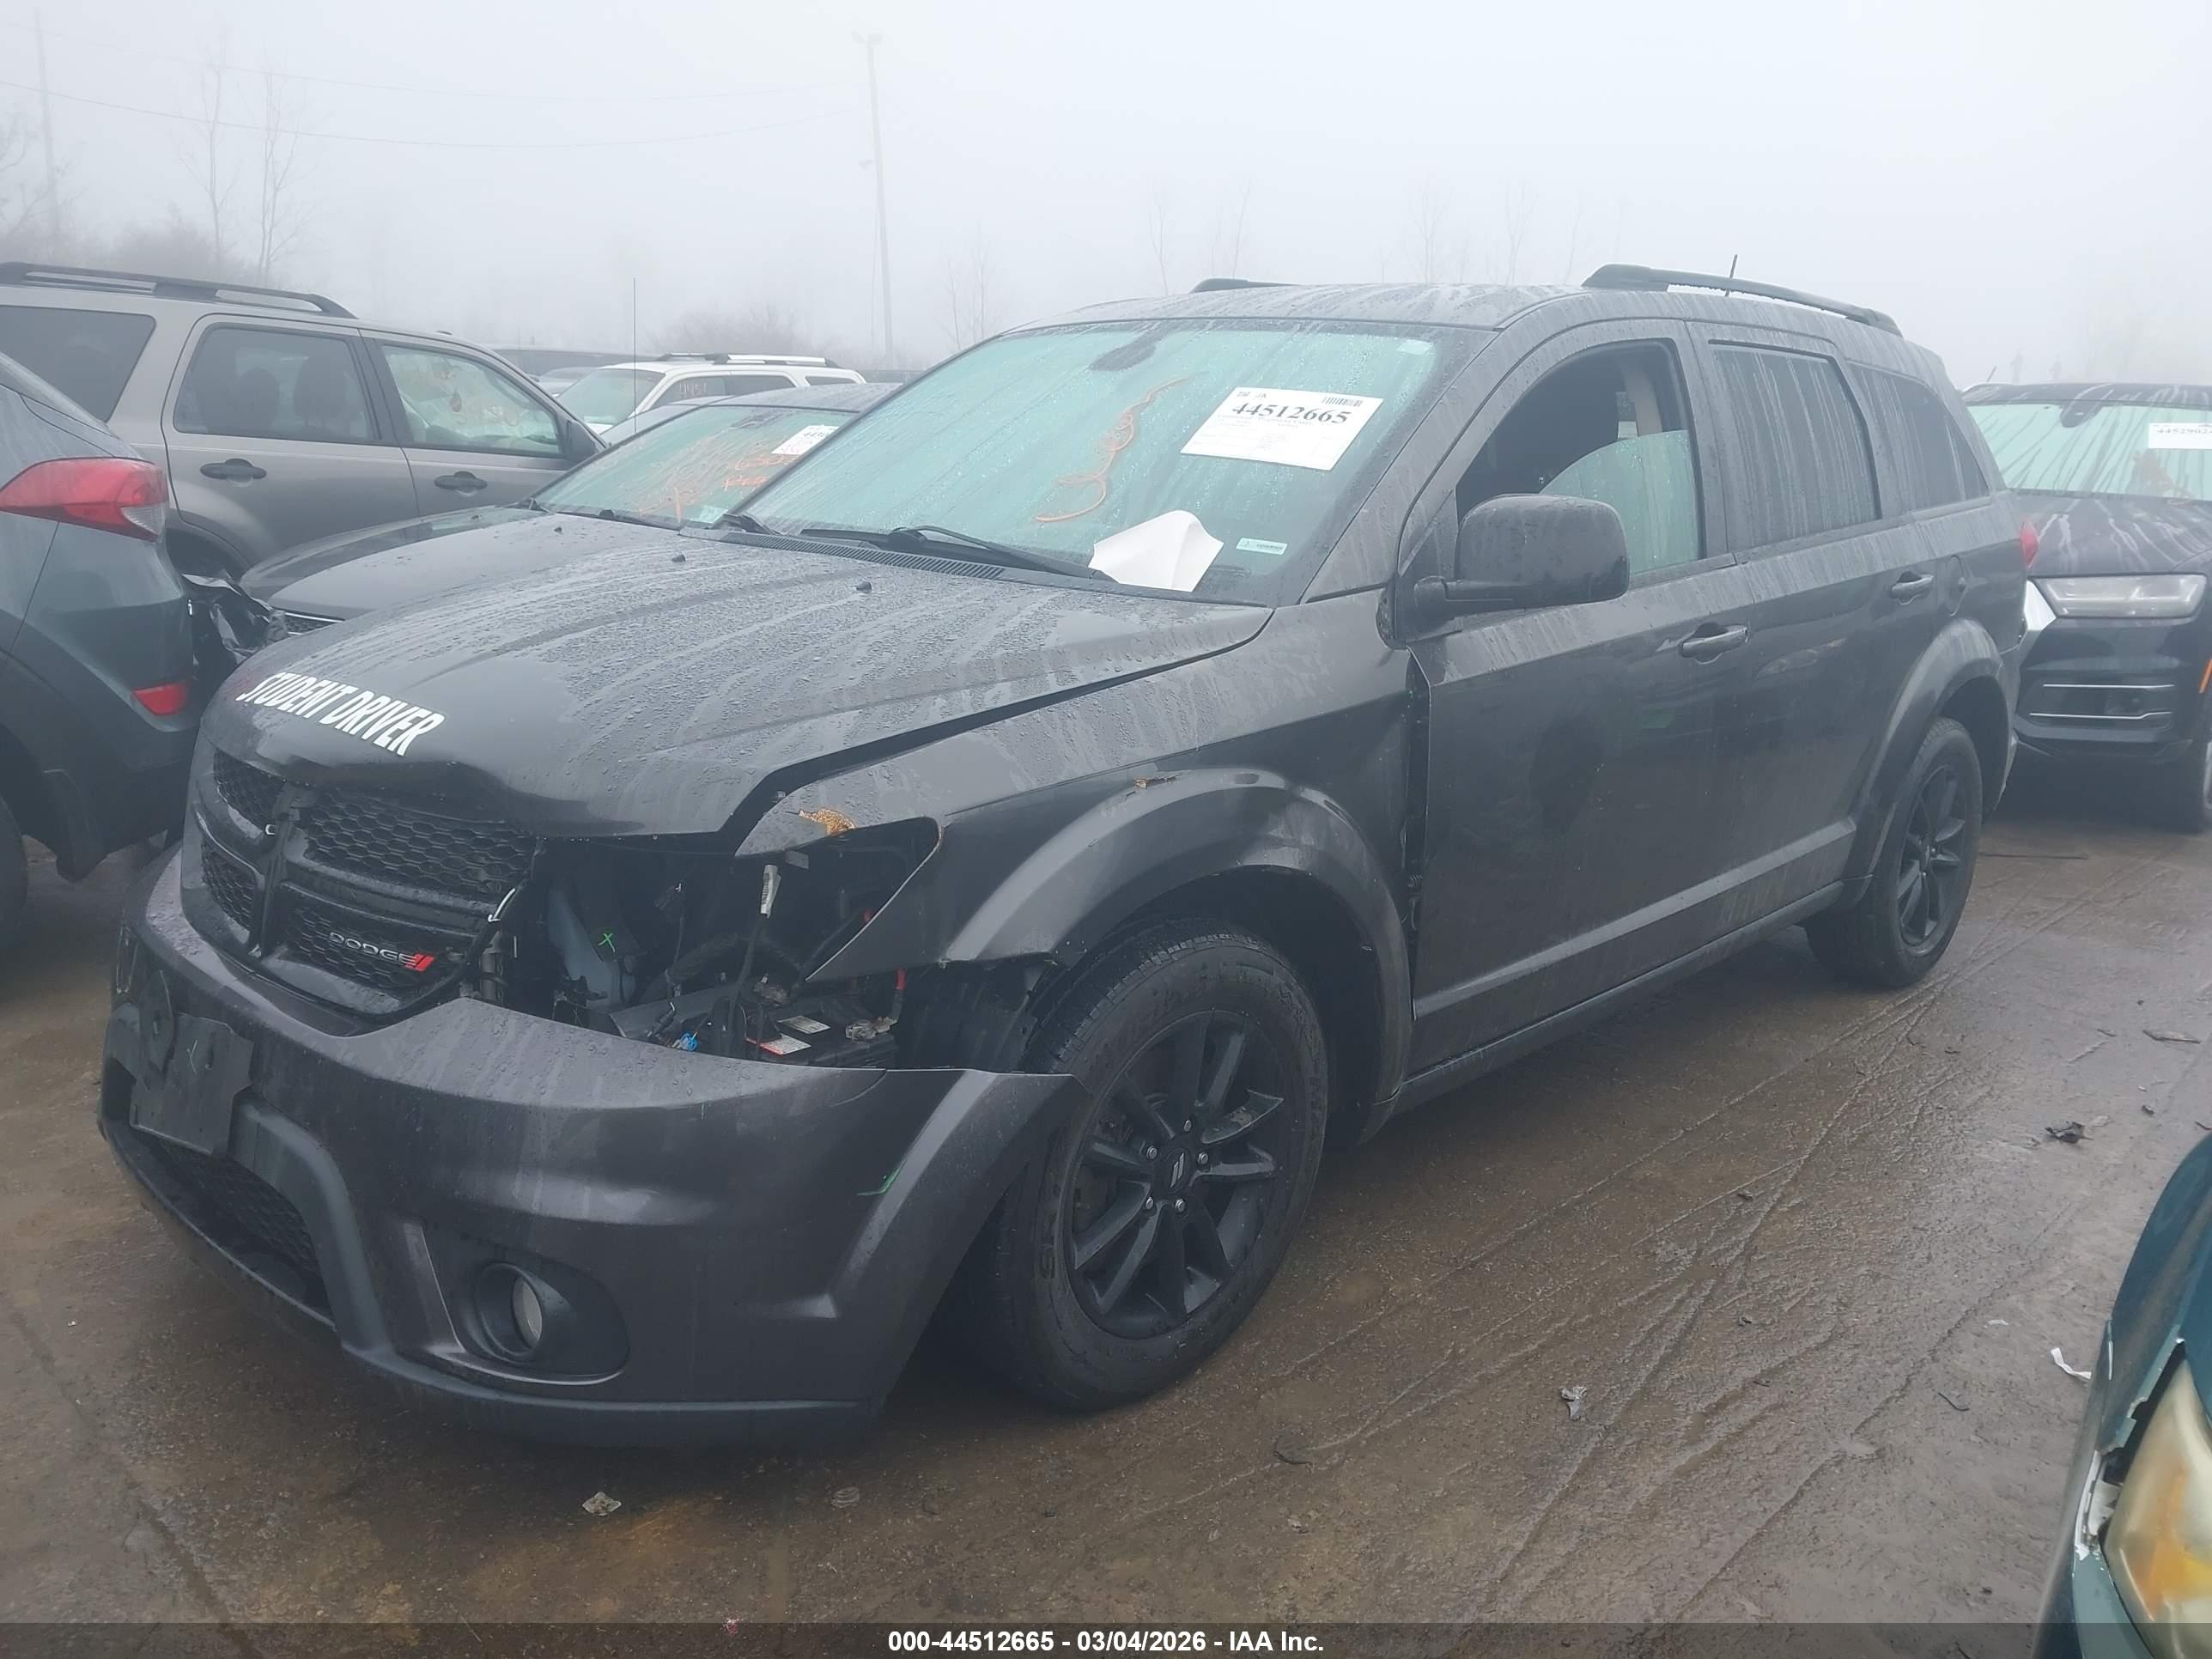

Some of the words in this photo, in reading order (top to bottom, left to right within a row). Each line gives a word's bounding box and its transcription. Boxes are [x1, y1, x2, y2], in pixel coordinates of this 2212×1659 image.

[1232, 402, 1352, 423] 44512665
[235, 672, 359, 718] STUDENT
[319, 690, 446, 756] DRIVER
[329, 932, 416, 966] DODGE
